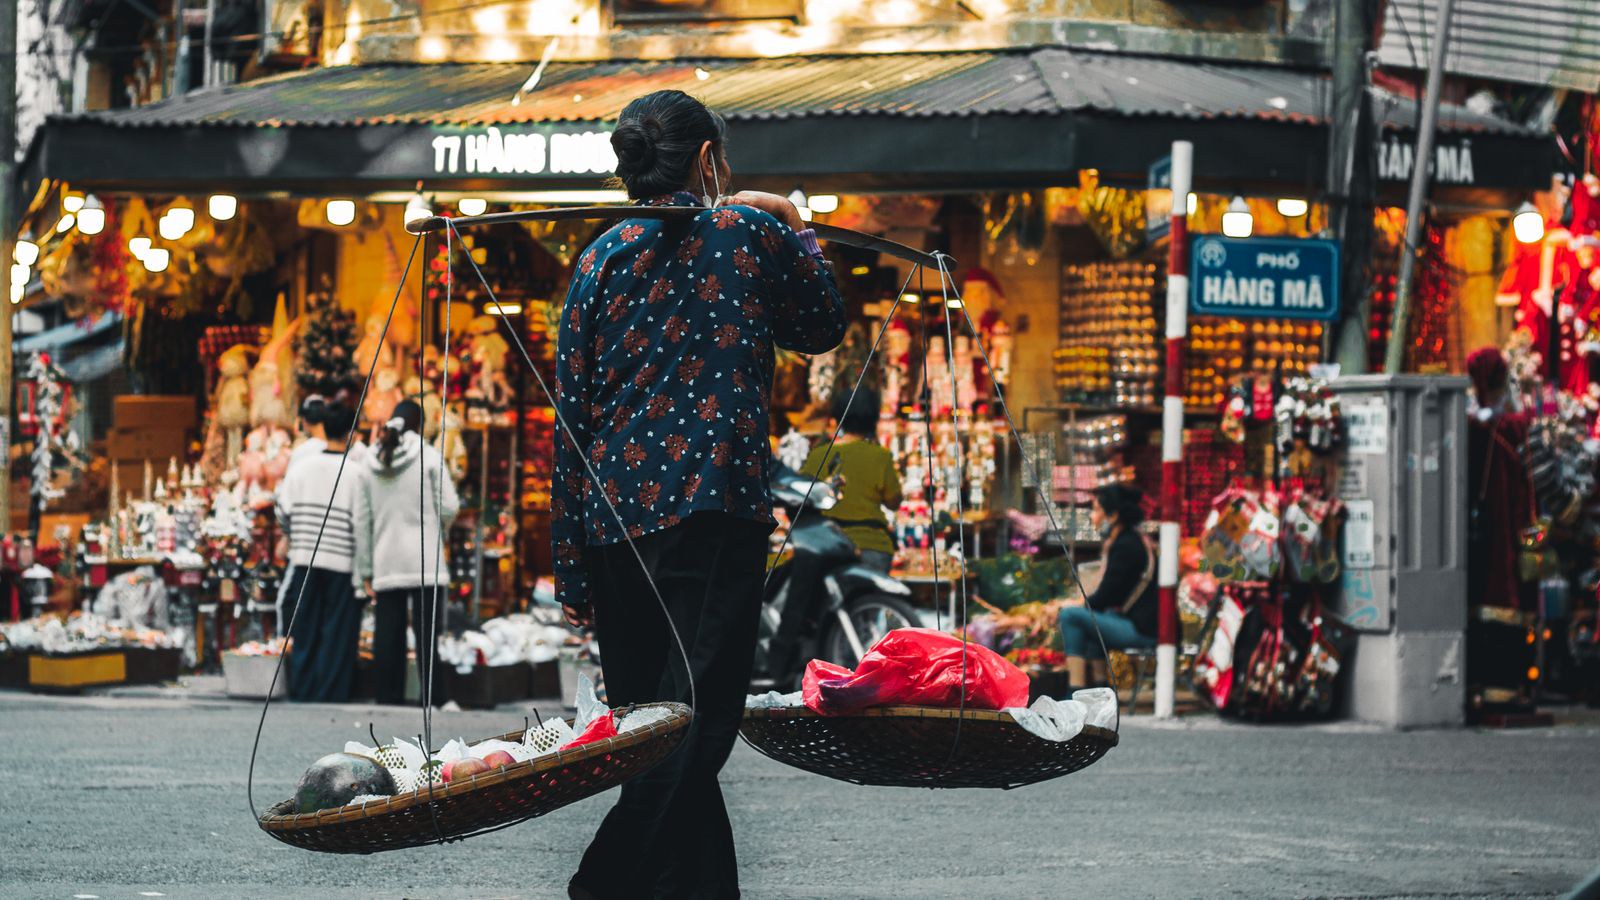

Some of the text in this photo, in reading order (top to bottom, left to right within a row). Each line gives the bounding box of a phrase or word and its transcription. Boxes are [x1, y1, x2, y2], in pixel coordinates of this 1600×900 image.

[432, 135, 461, 173] 17
[465, 127, 546, 174] HÀNG
[1437, 138, 1474, 184] MÃ
[1257, 249, 1300, 270] PHỐ
[1203, 270, 1325, 309] HÀNG MÃ
